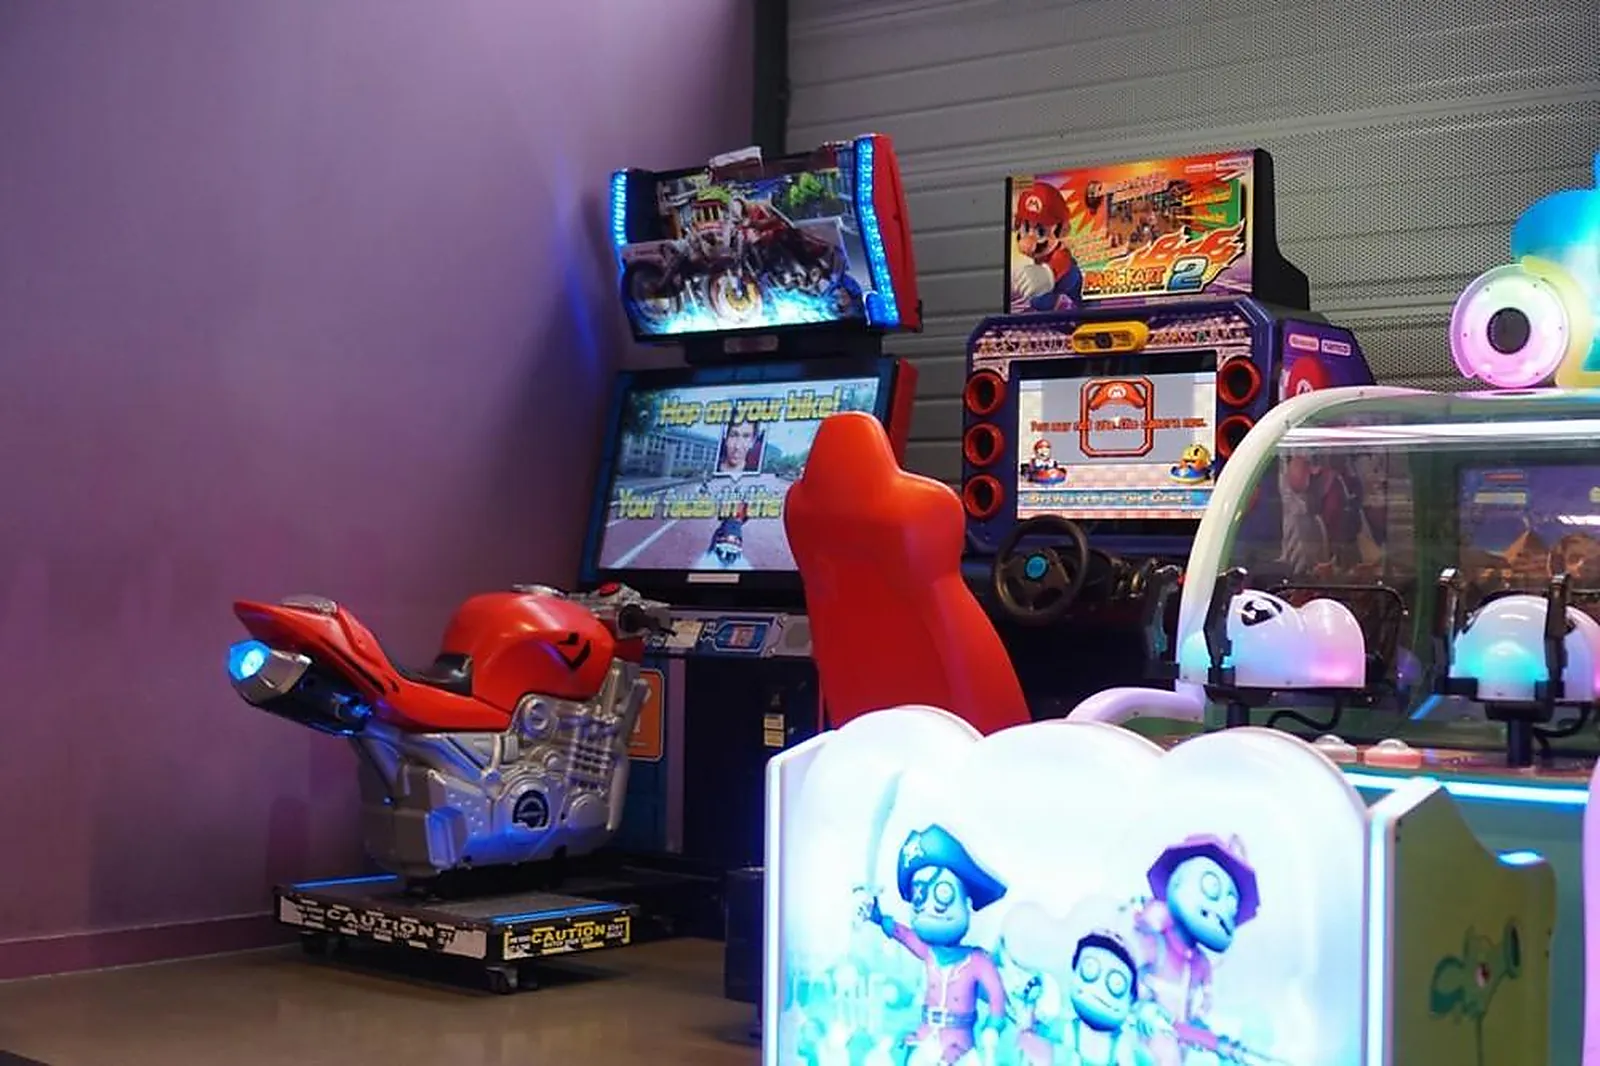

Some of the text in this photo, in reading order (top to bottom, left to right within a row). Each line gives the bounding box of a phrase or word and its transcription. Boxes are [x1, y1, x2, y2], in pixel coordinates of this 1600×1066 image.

[1167, 255, 1209, 291] 2
[659, 397, 702, 426] Hop
[704, 400, 732, 423] on
[734, 398, 783, 424] your
[326, 906, 434, 938] CAUTION
[531, 923, 606, 944] CAUTION
